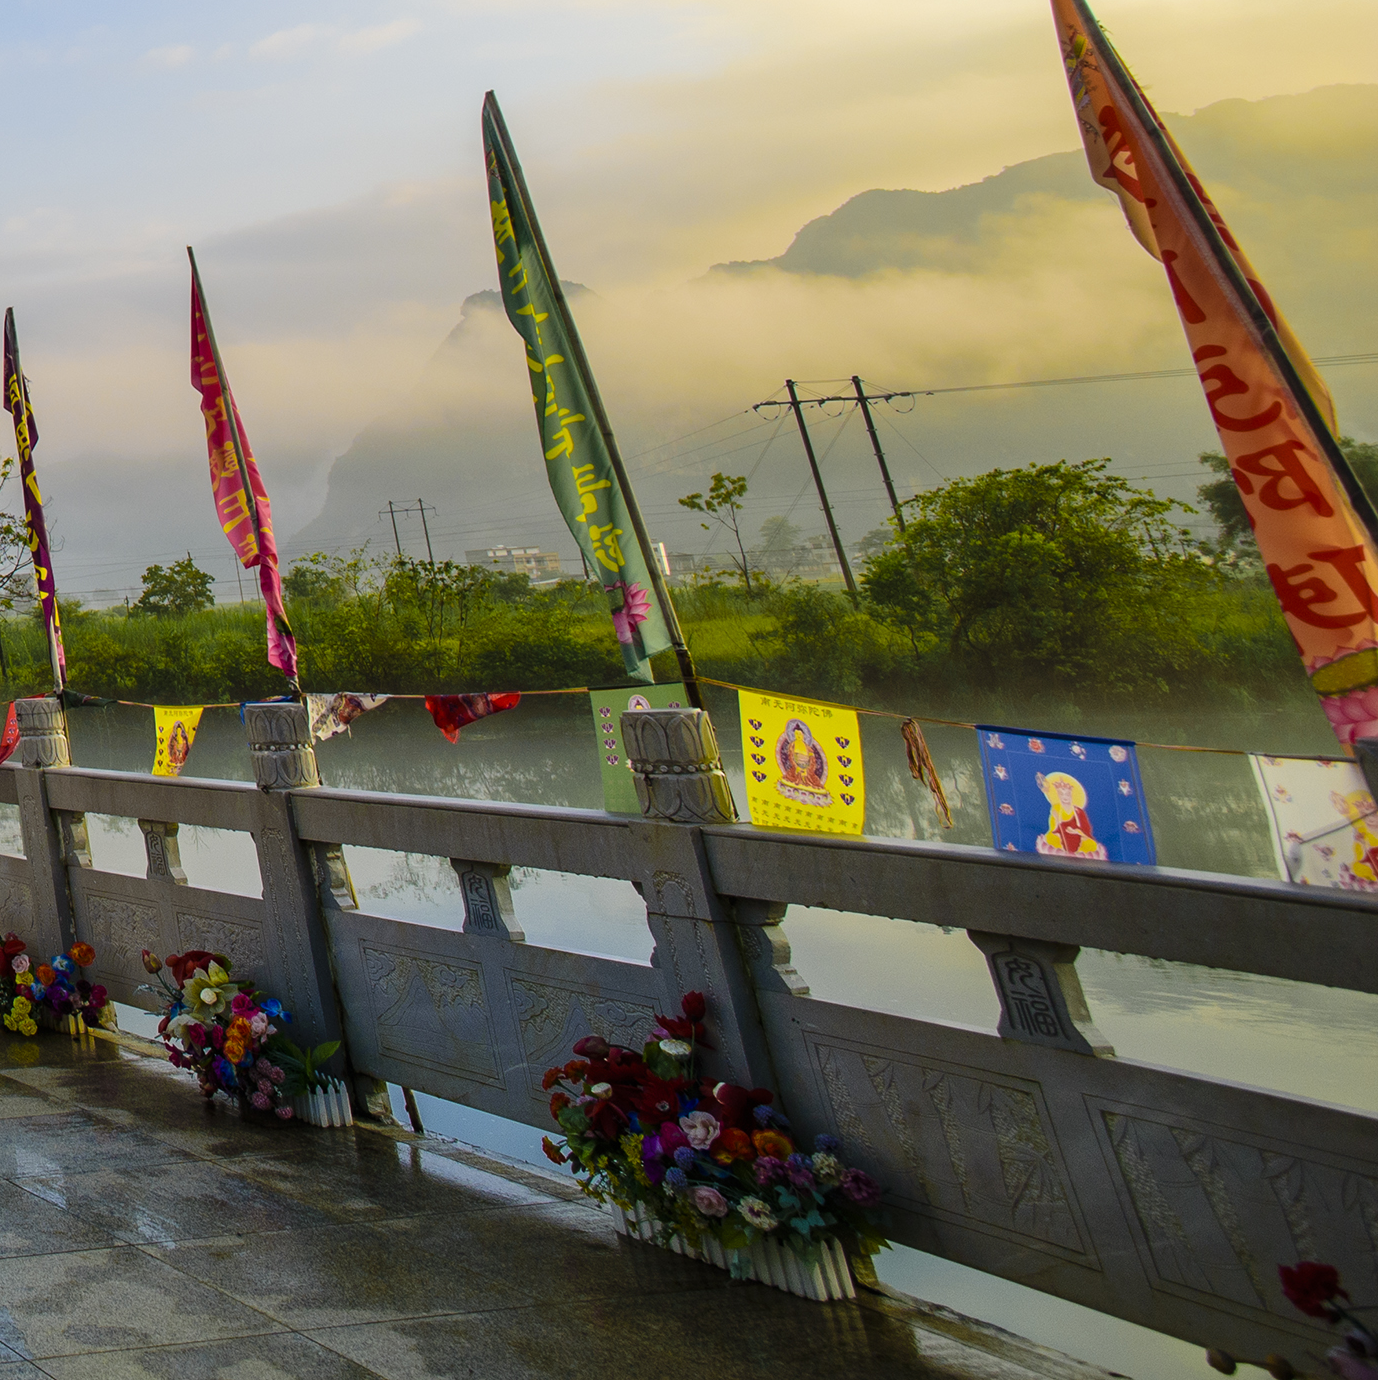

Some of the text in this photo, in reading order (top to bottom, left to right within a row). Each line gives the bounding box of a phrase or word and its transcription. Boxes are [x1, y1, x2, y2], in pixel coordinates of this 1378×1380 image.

[760, 696, 834, 719] 南无阿弥陀佛
